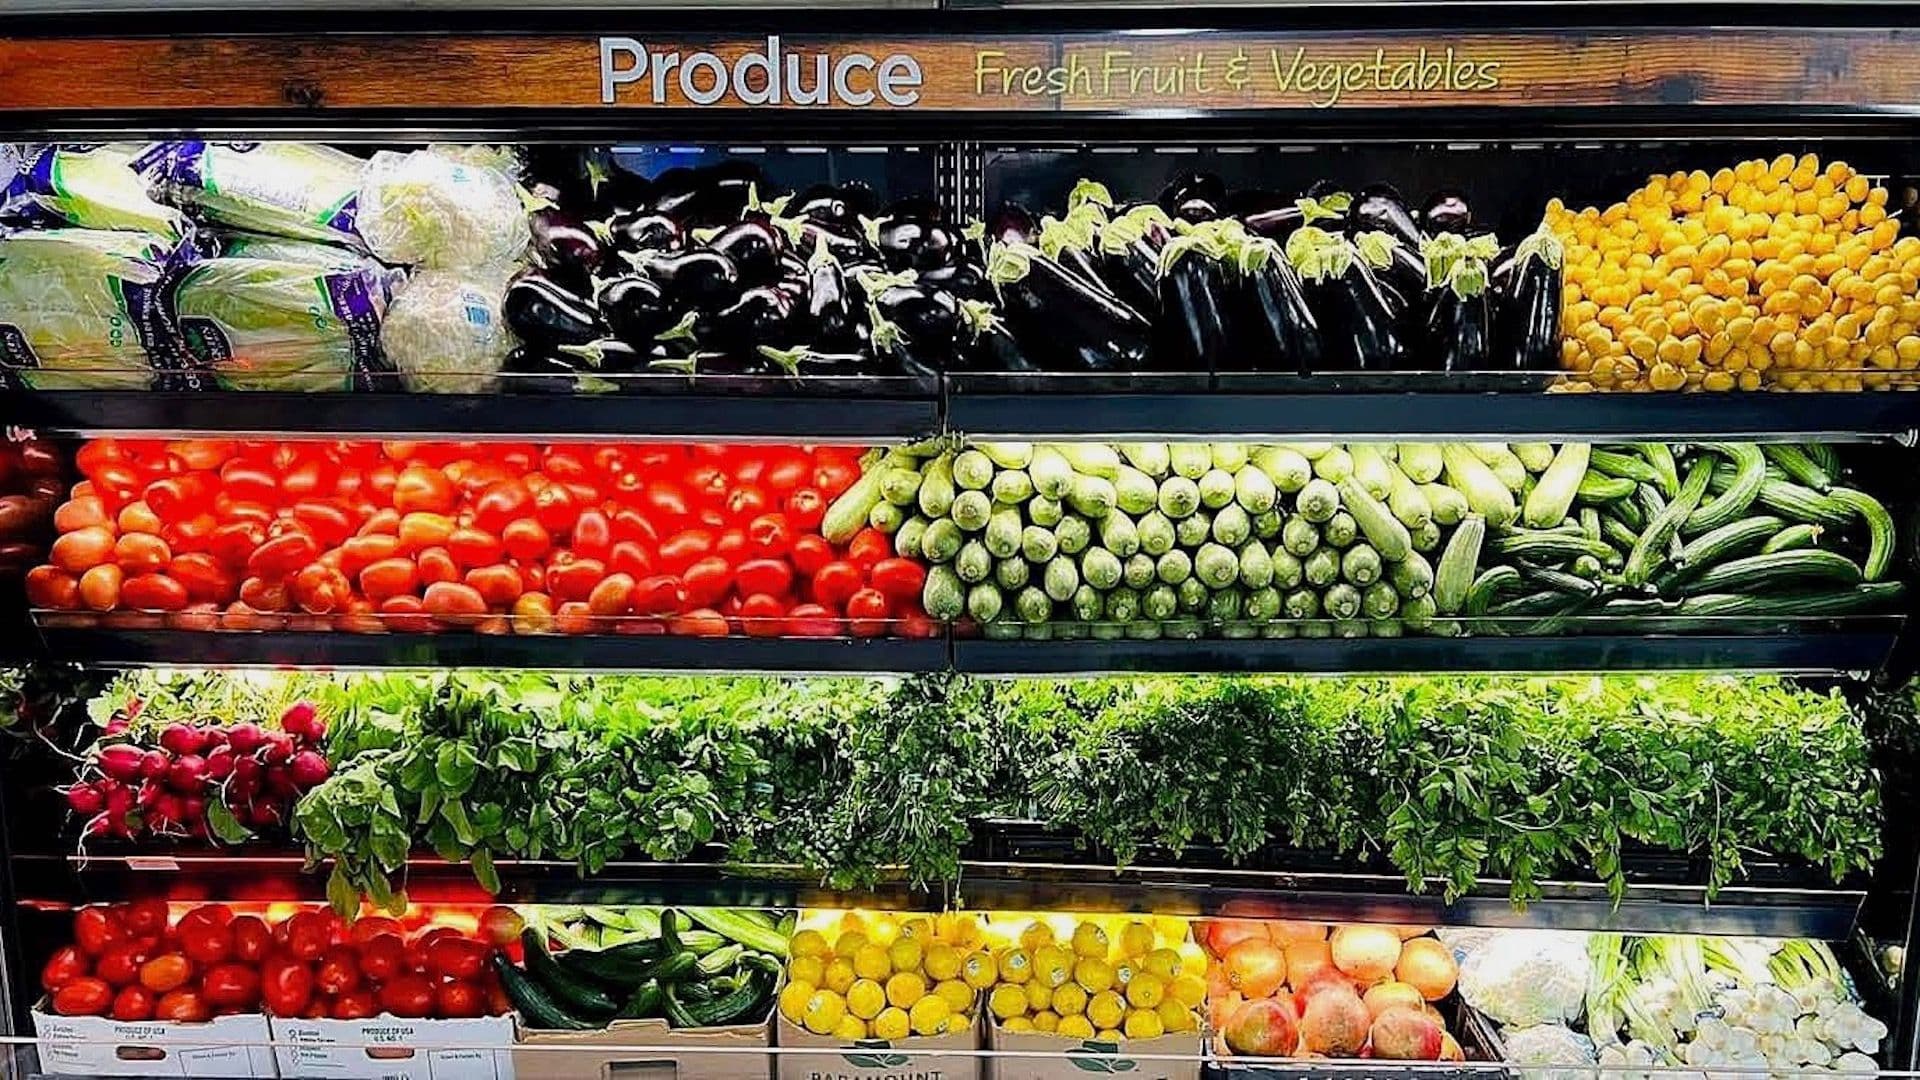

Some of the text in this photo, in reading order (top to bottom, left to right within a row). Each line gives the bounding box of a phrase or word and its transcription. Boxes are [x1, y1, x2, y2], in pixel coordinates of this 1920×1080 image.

[599, 36, 923, 107] Produce
[974, 46, 1501, 108] Fresh Fruit & Vegetables
[361, 1027, 390, 1035] PRODUCE
